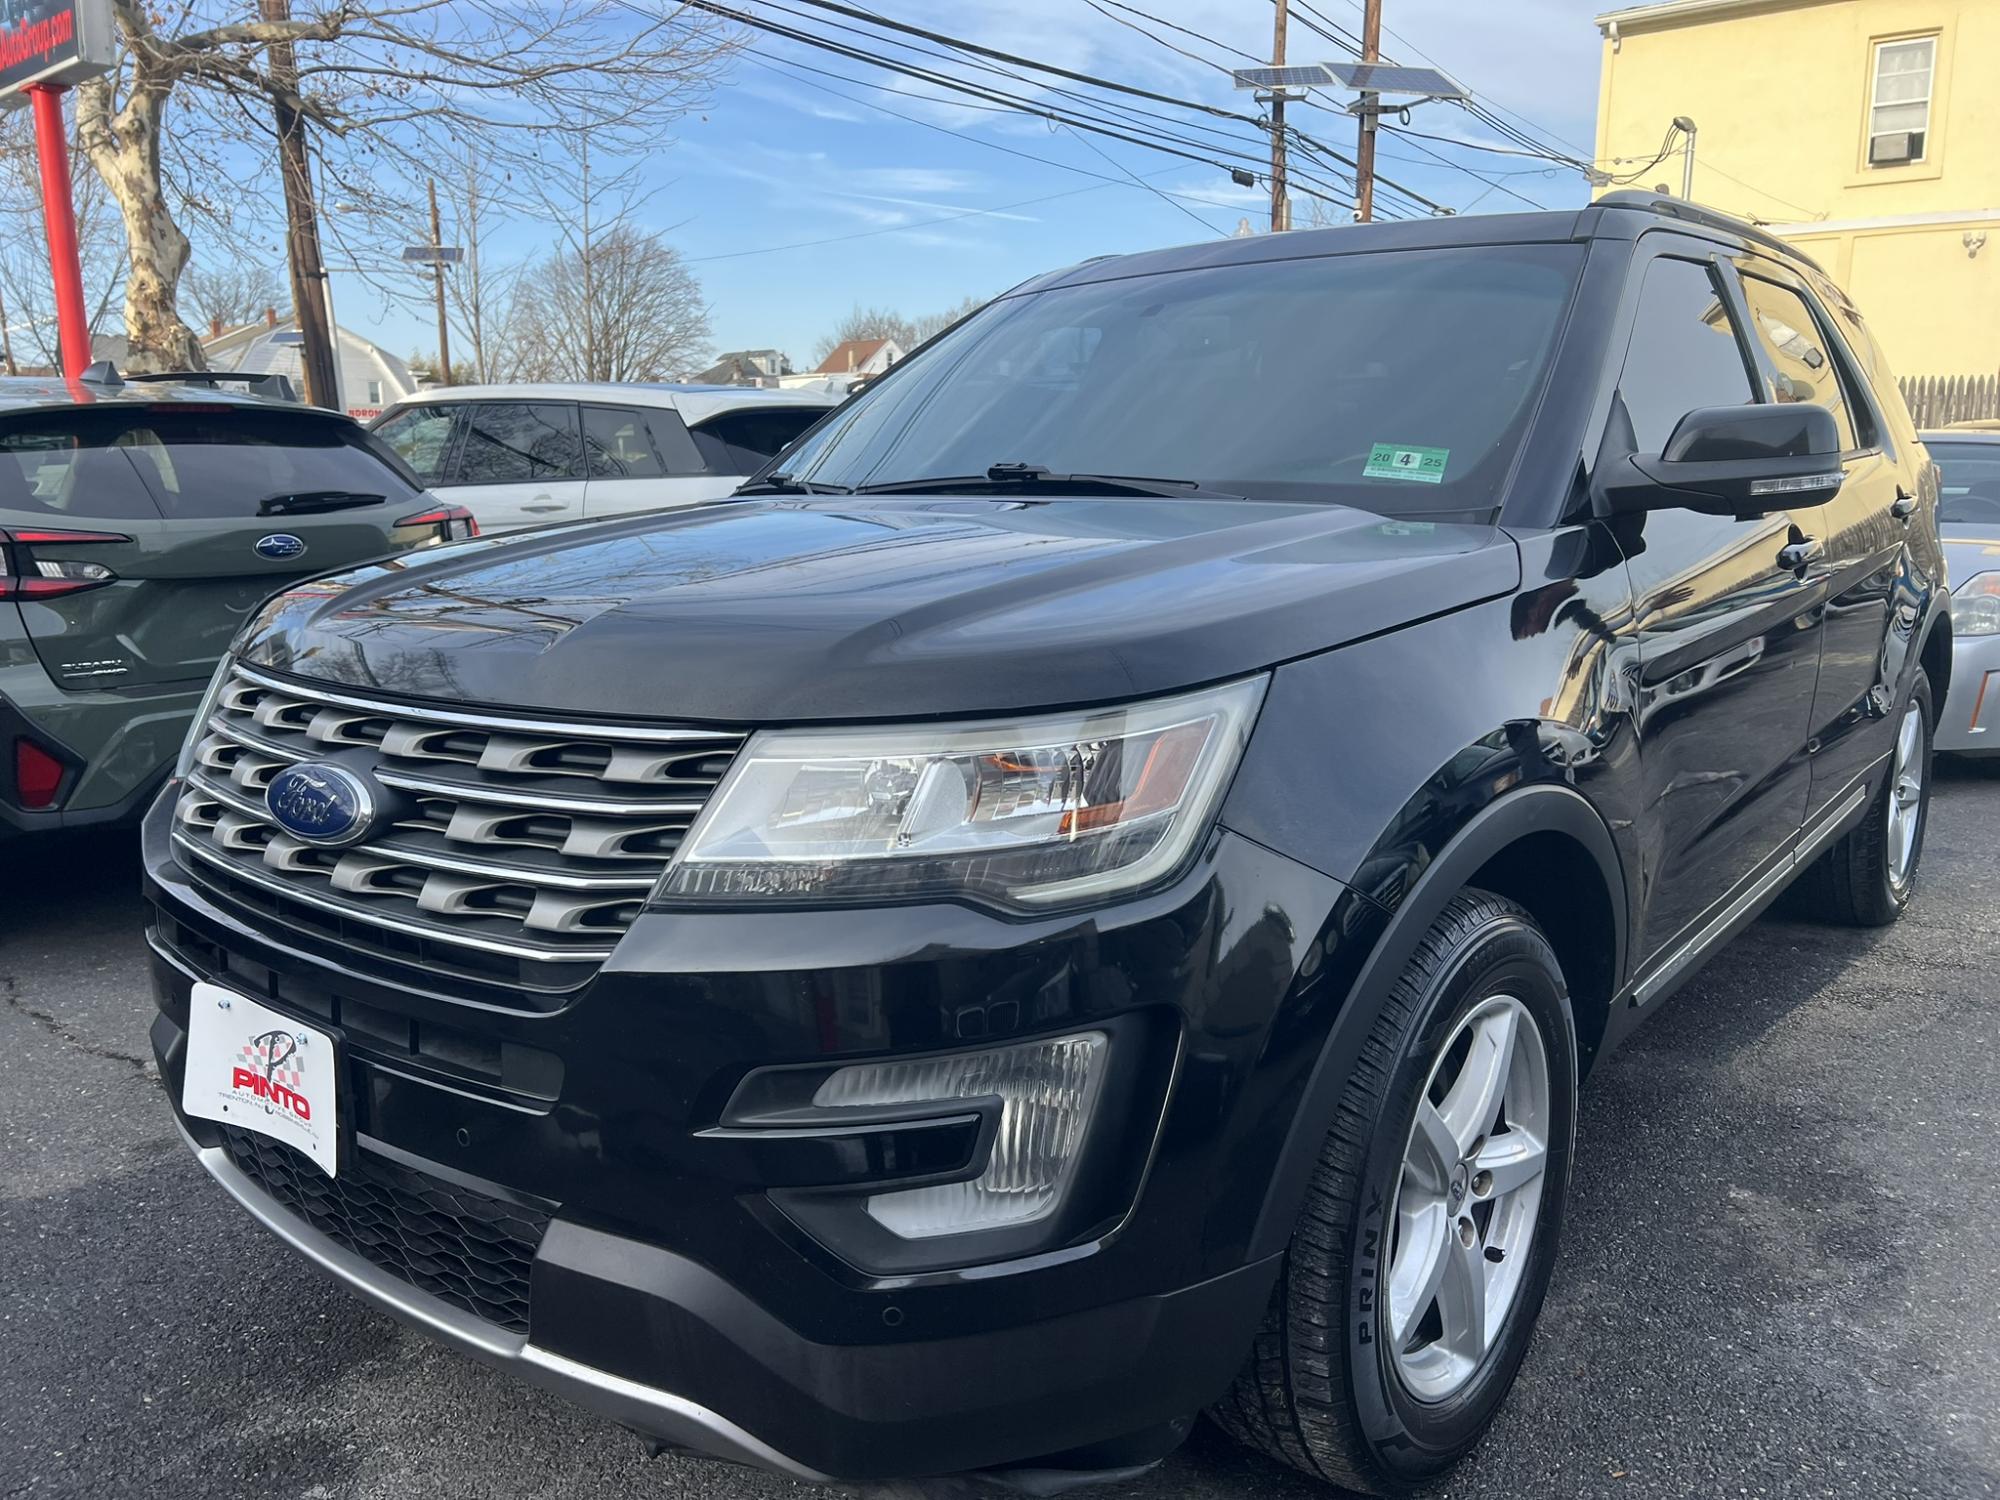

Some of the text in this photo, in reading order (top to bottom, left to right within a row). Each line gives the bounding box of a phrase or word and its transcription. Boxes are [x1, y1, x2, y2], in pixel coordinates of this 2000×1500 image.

[1374, 453, 1442, 467] 20 4 25
[278, 773, 337, 824] Ford
[232, 1066, 311, 1120] PINTO
